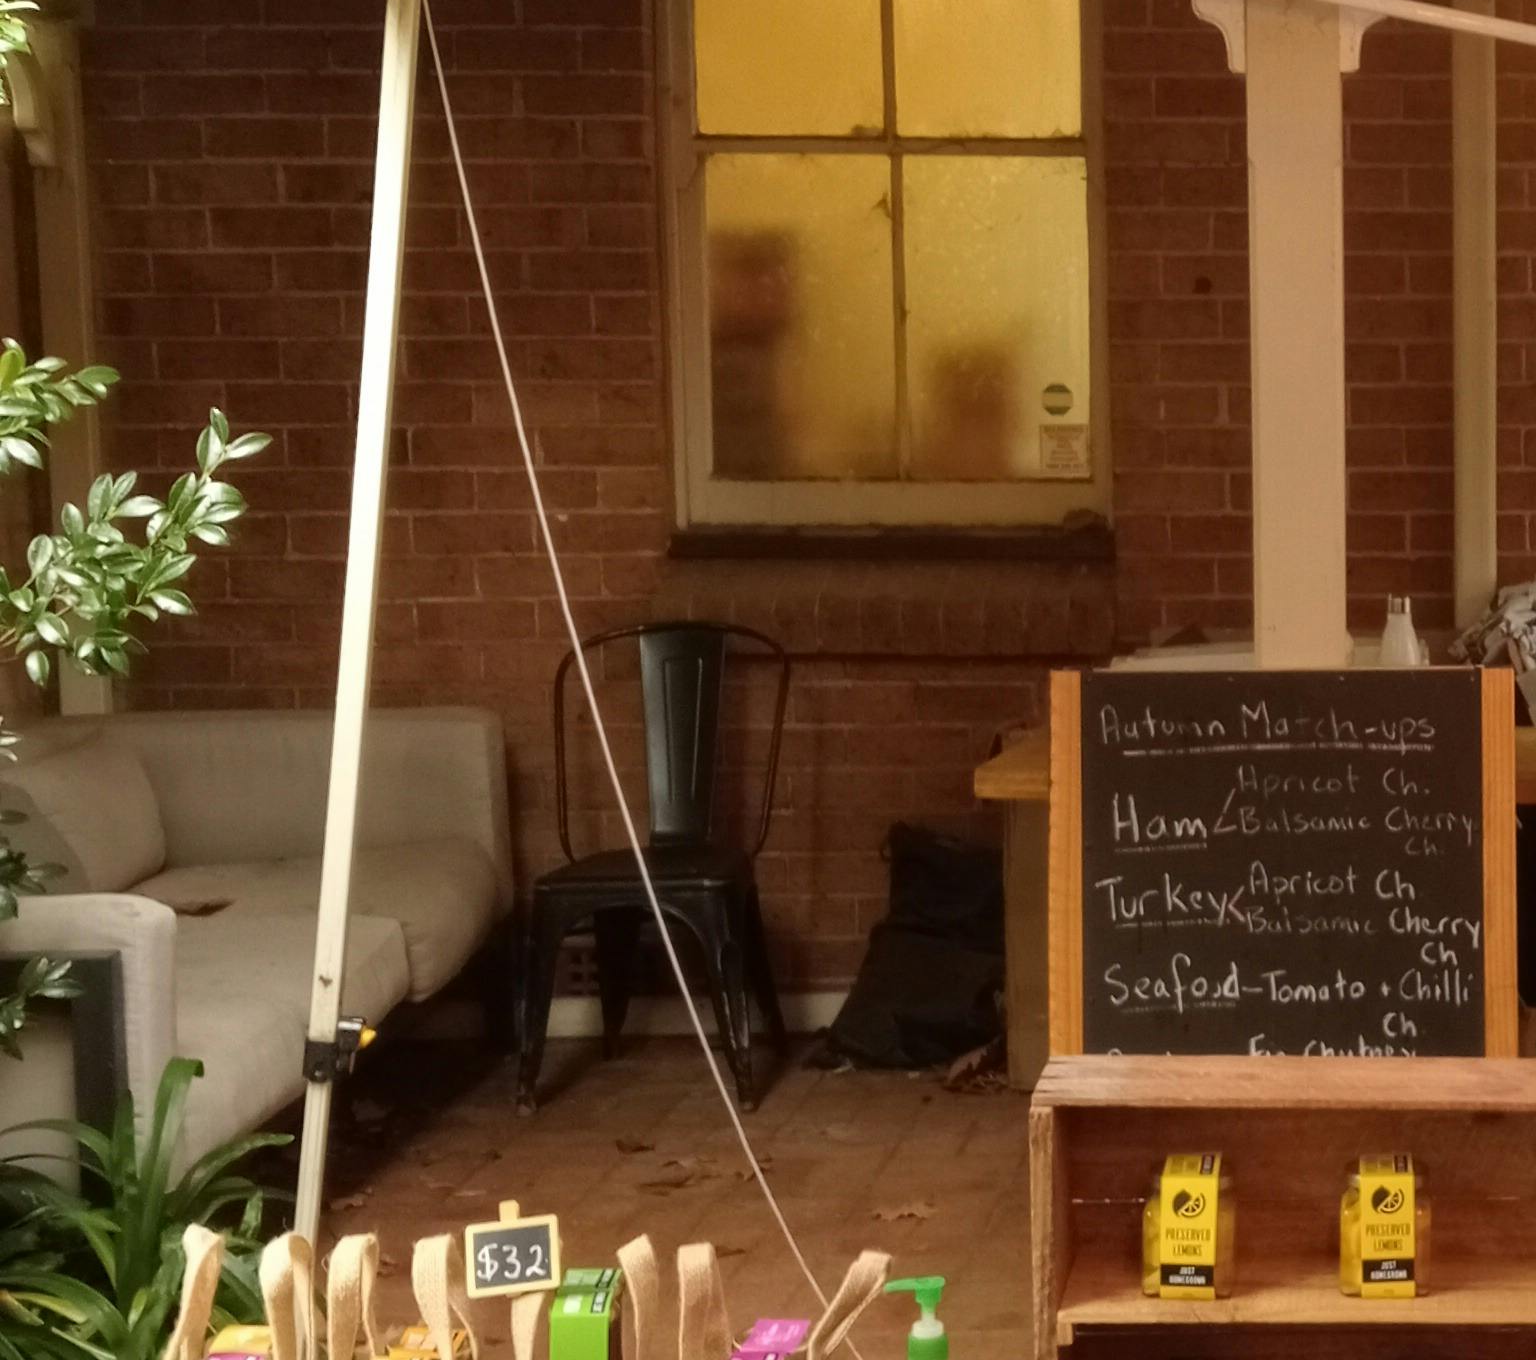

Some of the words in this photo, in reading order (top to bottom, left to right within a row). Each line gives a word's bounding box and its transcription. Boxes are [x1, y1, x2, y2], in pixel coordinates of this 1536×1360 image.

[1112, 792, 1208, 843] Ham
[1238, 805, 1371, 835] Balsamic
[1384, 806, 1473, 847] Cherry
[1095, 872, 1228, 927] Turkey
[1248, 860, 1357, 903] Apricot
[1388, 906, 1481, 949] Cherry
[1420, 941, 1459, 966] Ch
[1104, 953, 1240, 1014] Seafood
[1262, 968, 1366, 1003] Tomato
[1400, 967, 1474, 1006] Chilli
[1382, 1011, 1418, 1037] Ch
[1165, 1227, 1212, 1241] PRESERVED
[1365, 1222, 1411, 1237] PRESERVED
[1173, 1243, 1203, 1257] LEMONS
[1373, 1238, 1403, 1252] LEMONS
[1179, 1266, 1196, 1276] JUST
[1380, 1260, 1397, 1271] JUST
[1169, 1274, 1207, 1286] HOMEGROWN
[1370, 1270, 1408, 1280] HOMEGROWN
